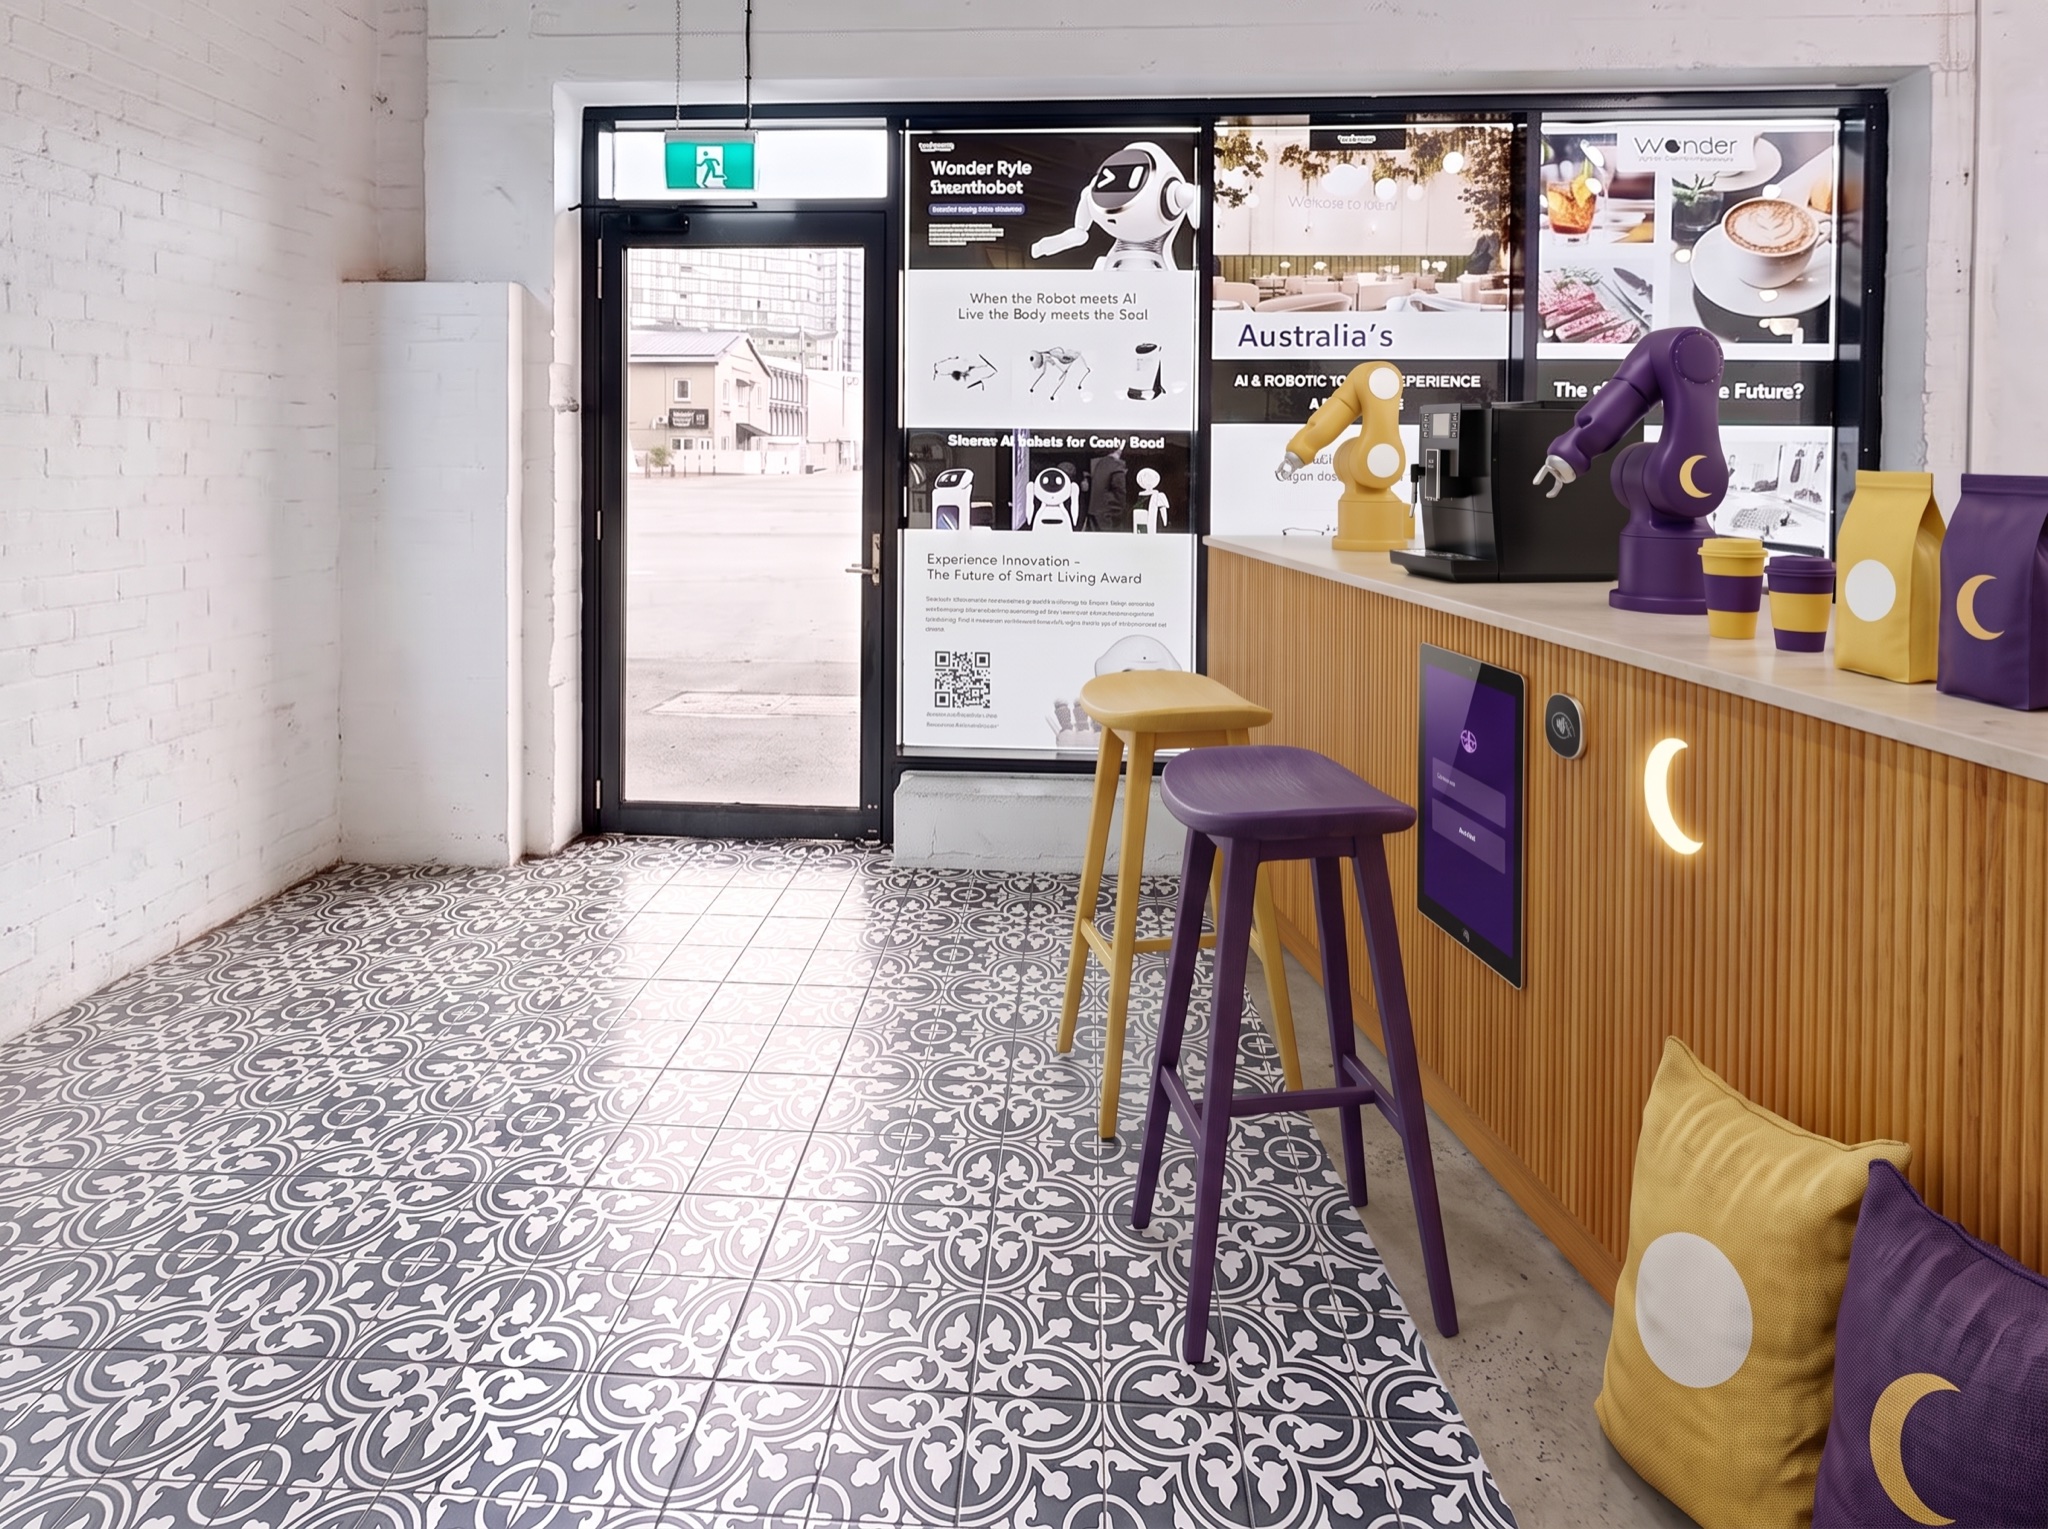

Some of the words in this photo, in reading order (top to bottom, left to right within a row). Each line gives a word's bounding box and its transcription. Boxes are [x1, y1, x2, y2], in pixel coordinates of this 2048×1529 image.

[930, 160, 994, 176] Wonder
[997, 160, 1033, 178] Ryle
[970, 293, 1008, 304] When
[1011, 293, 1032, 304] the
[1037, 293, 1076, 304] Robot
[1080, 294, 1119, 304] meets
[1122, 293, 1137, 304] AI
[958, 308, 984, 320] Live
[989, 308, 1009, 320] the
[1013, 308, 1046, 323] Body
[1051, 309, 1090, 320] meets
[1094, 309, 1114, 321] the
[1238, 323, 1393, 348] Australia's
[1234, 375, 1248, 387] AI
[1251, 375, 1261, 388] &
[1264, 375, 1327, 388] ROBOTIC
[1553, 381, 1587, 398] The
[1734, 382, 1805, 400] Future?
[1066, 436, 1086, 448] for
[927, 553, 998, 567] Experience
[1002, 554, 1070, 567] Innovation
[927, 569, 950, 581] The
[954, 569, 994, 581] Future
[998, 570, 1012, 581] of
[1015, 570, 1053, 582] Smart
[1057, 571, 1096, 586] Living
[1100, 573, 1142, 584] Award
